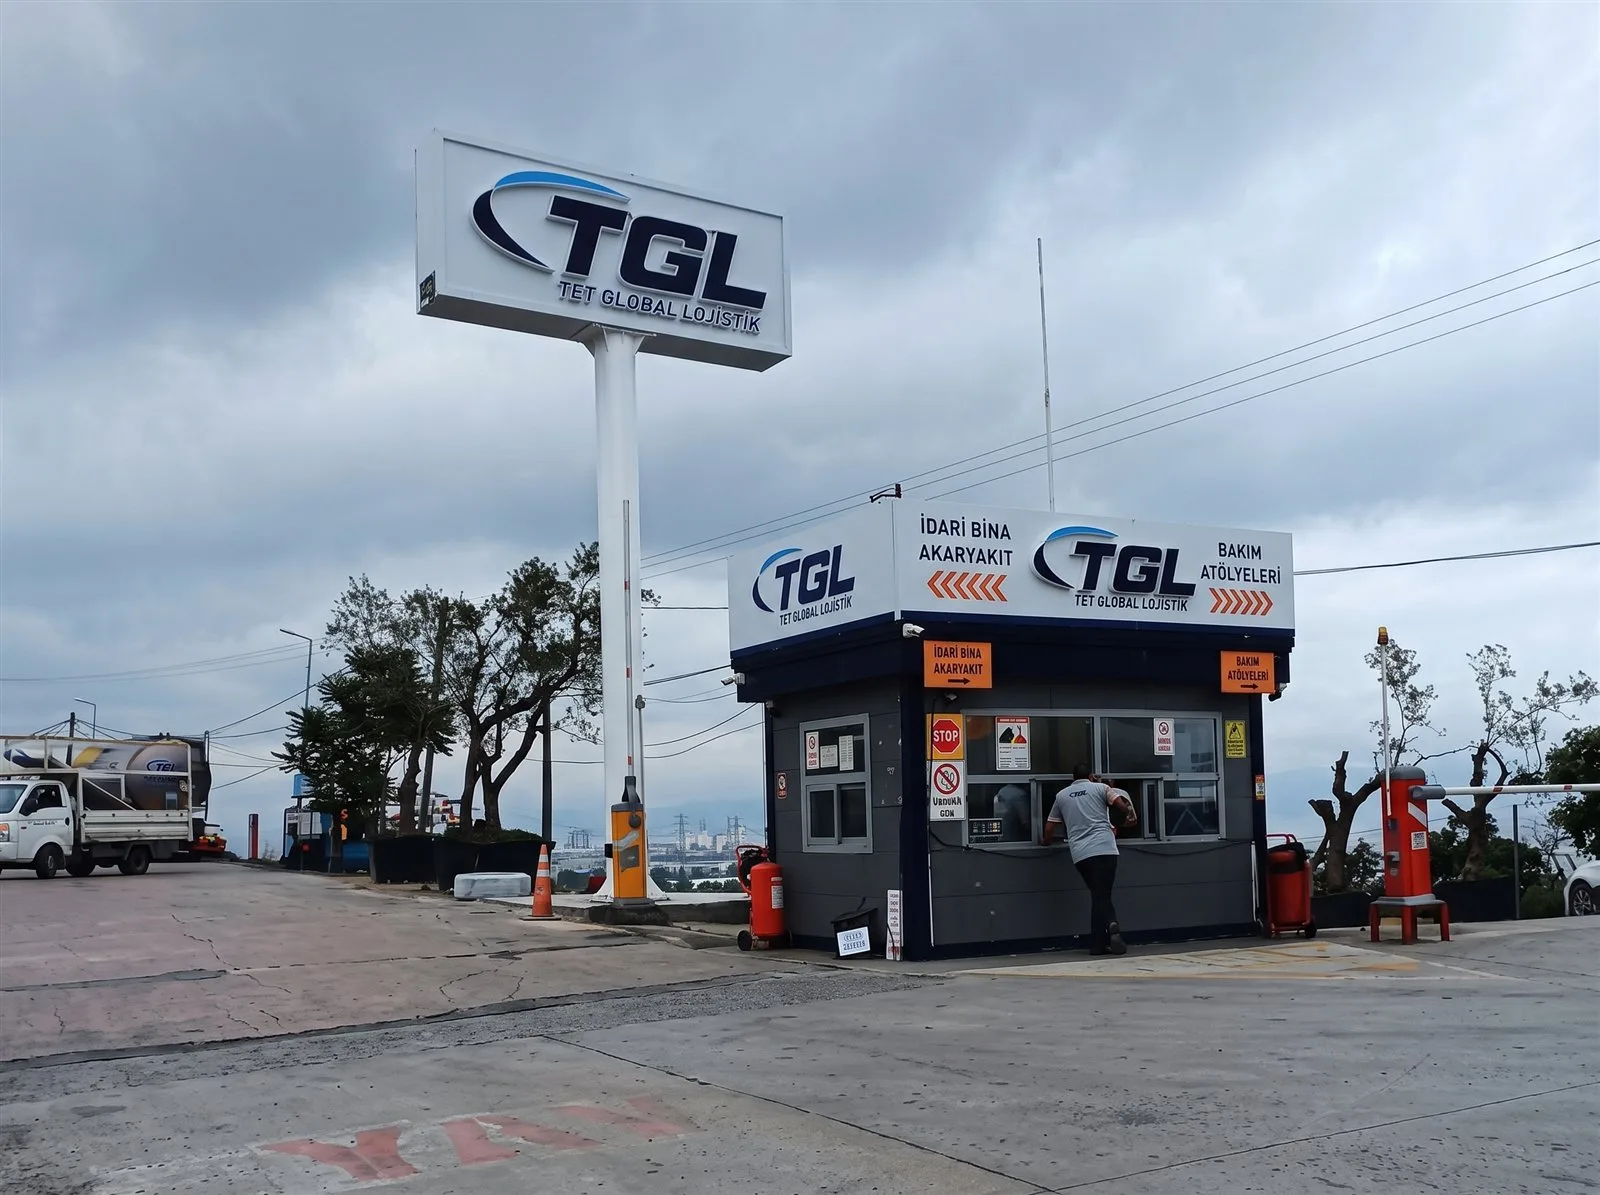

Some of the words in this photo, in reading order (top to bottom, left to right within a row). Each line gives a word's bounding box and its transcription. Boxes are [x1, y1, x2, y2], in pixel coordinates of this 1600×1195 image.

[548, 194, 767, 310] TGL
[559, 281, 597, 302] TET
[601, 289, 677, 317] GLOBAL
[683, 303, 761, 333] LOJİSTİK
[920, 513, 966, 537] İDARİ
[971, 518, 1012, 540] BİNA
[919, 544, 1014, 566] AKARYAKIT
[1218, 542, 1262, 560] BAKIM
[774, 544, 856, 612] TGL
[1072, 541, 1197, 596] TGL
[1200, 564, 1282, 585] ATÖLYELERİ
[780, 612, 792, 626] TET
[792, 606, 819, 623] GLOBAL
[820, 594, 853, 615] LOJİSTİK
[1074, 594, 1095, 607] TET
[1097, 596, 1140, 609] GLOBAL
[1142, 597, 1188, 611] LOJİSTİK
[934, 643, 958, 659] İDARİ
[961, 645, 982, 659] BİNA
[1236, 656, 1259, 667] BAKIM
[934, 663, 983, 675] AKARYAKIT
[1227, 668, 1269, 681] ATÖLYELERİ
[933, 730, 959, 743] STOP
